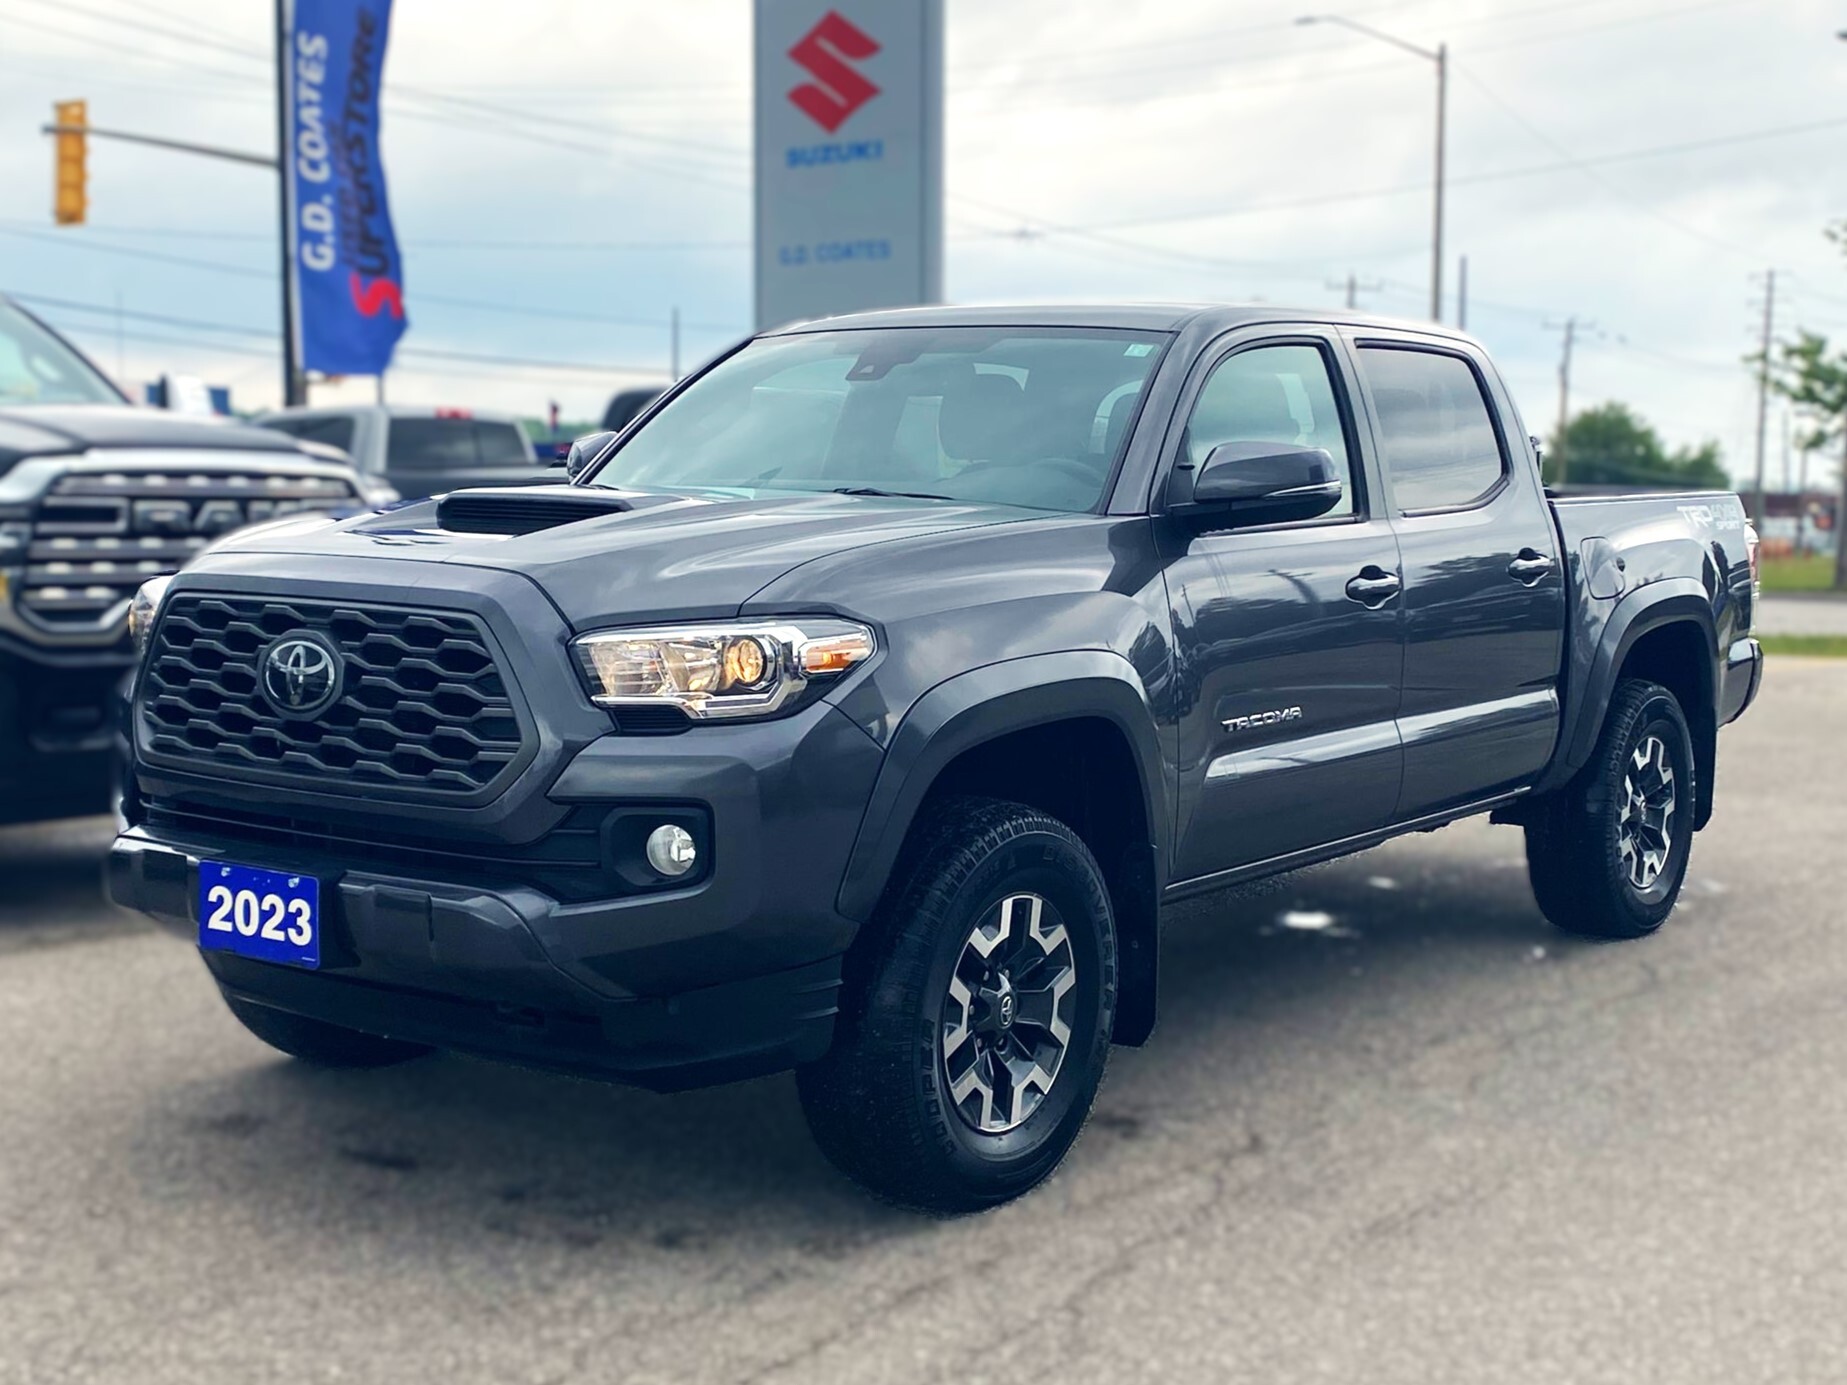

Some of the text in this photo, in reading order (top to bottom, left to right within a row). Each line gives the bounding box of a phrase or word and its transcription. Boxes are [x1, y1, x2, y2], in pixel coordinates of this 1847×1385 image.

[297, 30, 336, 271] G.D. COATES
[786, 141, 884, 168] SUZUKI
[815, 240, 891, 262] COATES
[1677, 505, 1714, 528] TRD
[1222, 705, 1302, 732] TACOMA
[207, 885, 312, 946] 2023
